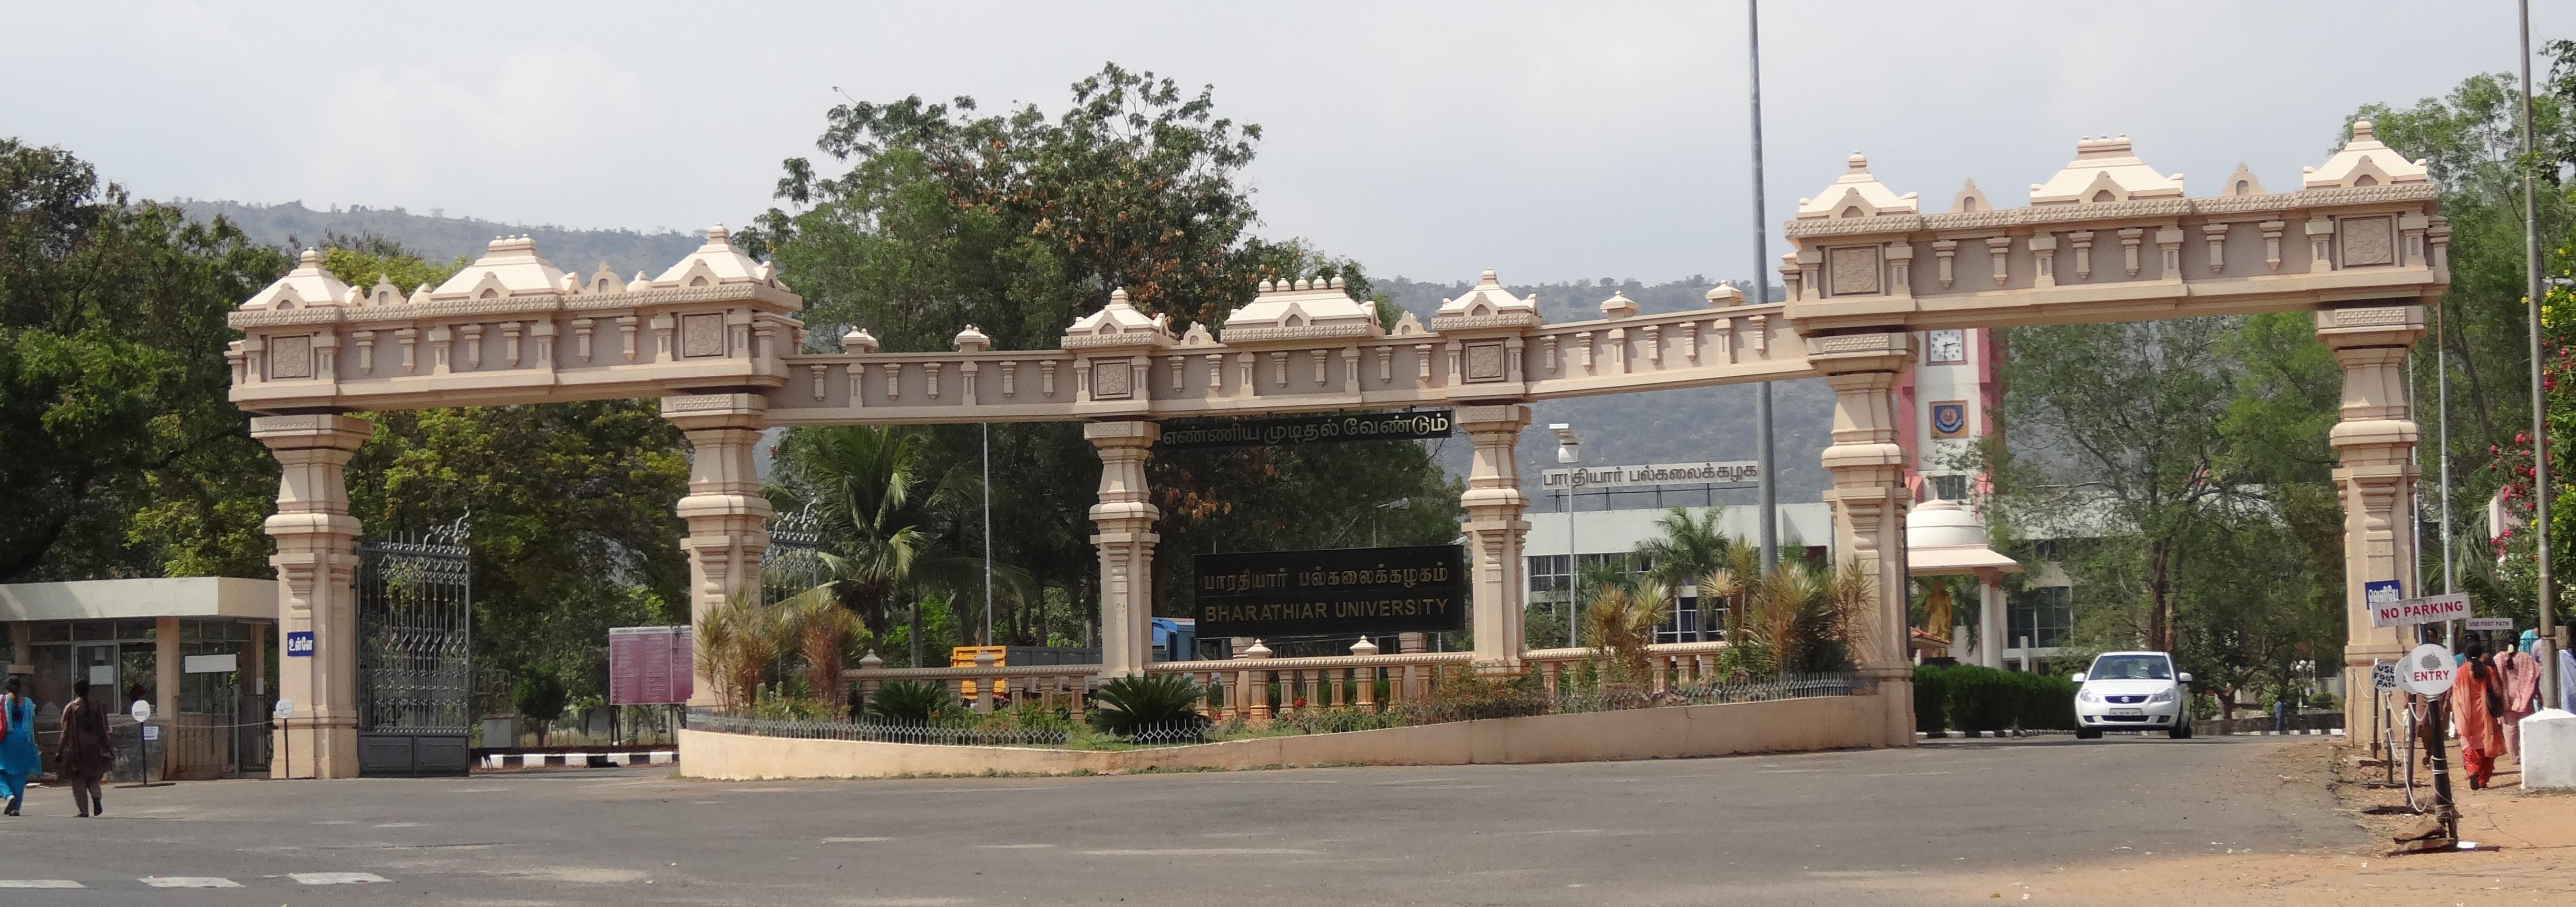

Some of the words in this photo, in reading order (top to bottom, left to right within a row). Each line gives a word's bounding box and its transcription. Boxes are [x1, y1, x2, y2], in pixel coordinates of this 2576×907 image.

[1163, 423, 1260, 445] எண்ணிய
[1264, 418, 1340, 444] முடிதல்
[1344, 413, 1449, 436] வேண்டும்
[1629, 463, 1757, 482] பல்கலைக்கழக
[1204, 568, 1289, 591] பாரதியார்
[1299, 561, 1448, 588] பல்கலைக்கழகம்
[1205, 602, 1328, 622] BHARATHIAR
[1335, 598, 1449, 618] UNIVERSITY
[2380, 608, 2399, 620] NO
[2404, 600, 2463, 617] PARKING
[2374, 672, 2395, 682] FOOT
[2377, 665, 2395, 674] USE
[2414, 670, 2450, 682] ENTRY
